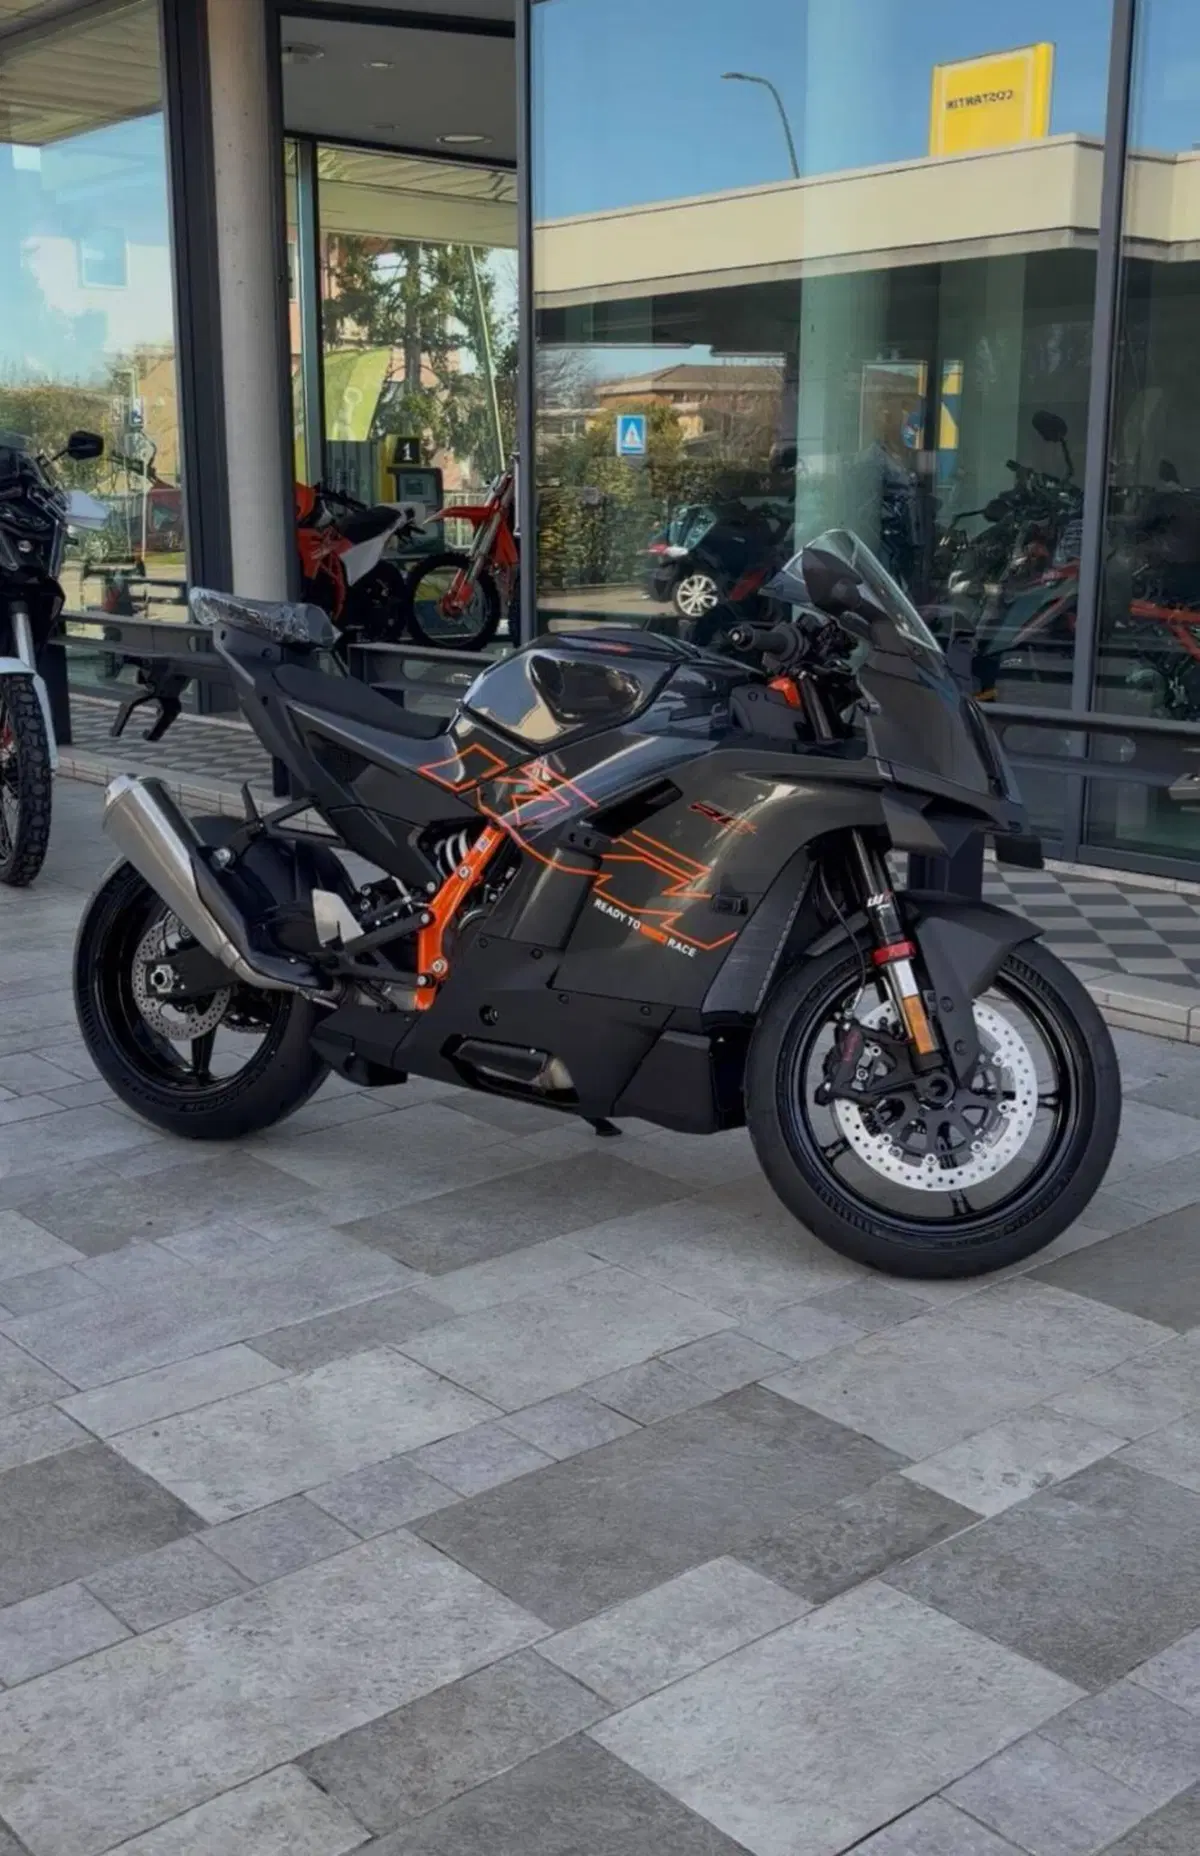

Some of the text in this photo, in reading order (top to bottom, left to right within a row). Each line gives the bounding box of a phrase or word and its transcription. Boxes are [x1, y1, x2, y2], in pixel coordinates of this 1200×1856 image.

[403, 442, 413, 461] 1
[593, 898, 697, 958] READY TO RACE
